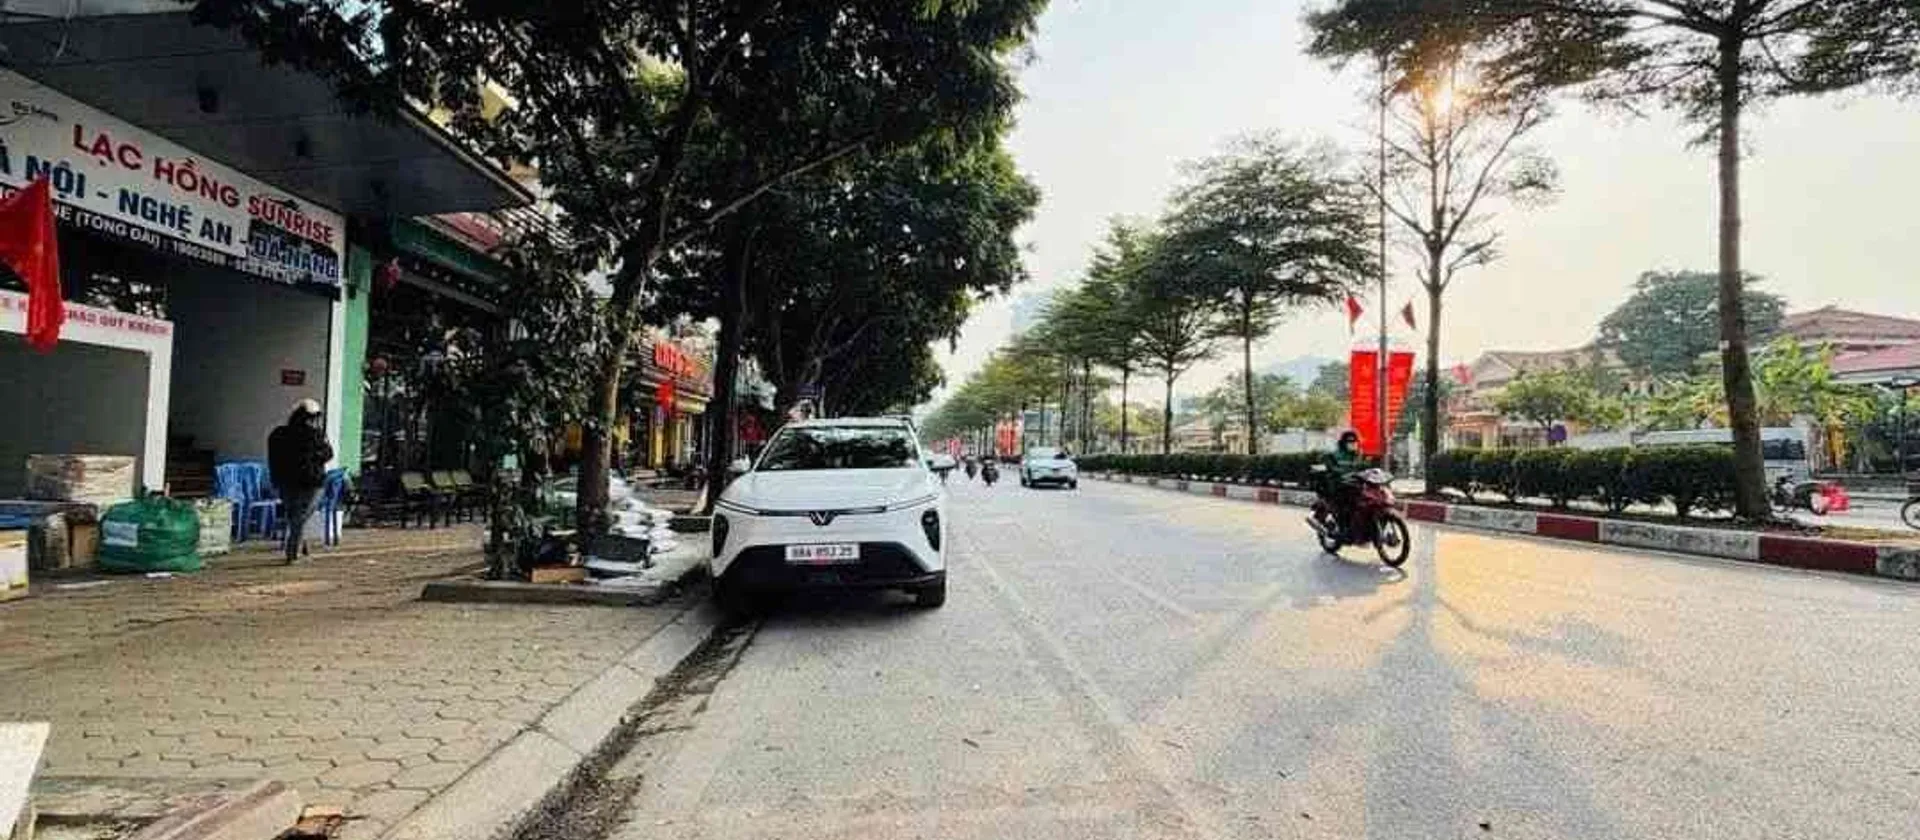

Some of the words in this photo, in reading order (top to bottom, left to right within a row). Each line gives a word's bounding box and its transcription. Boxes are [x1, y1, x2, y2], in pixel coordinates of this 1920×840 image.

[26, 155, 86, 199] NỘI
[119, 188, 193, 239] NGHỆ
[200, 216, 233, 247] AN
[74, 124, 142, 170] LẠC
[154, 156, 240, 209] HỒNG
[247, 195, 335, 244] SUNRISE
